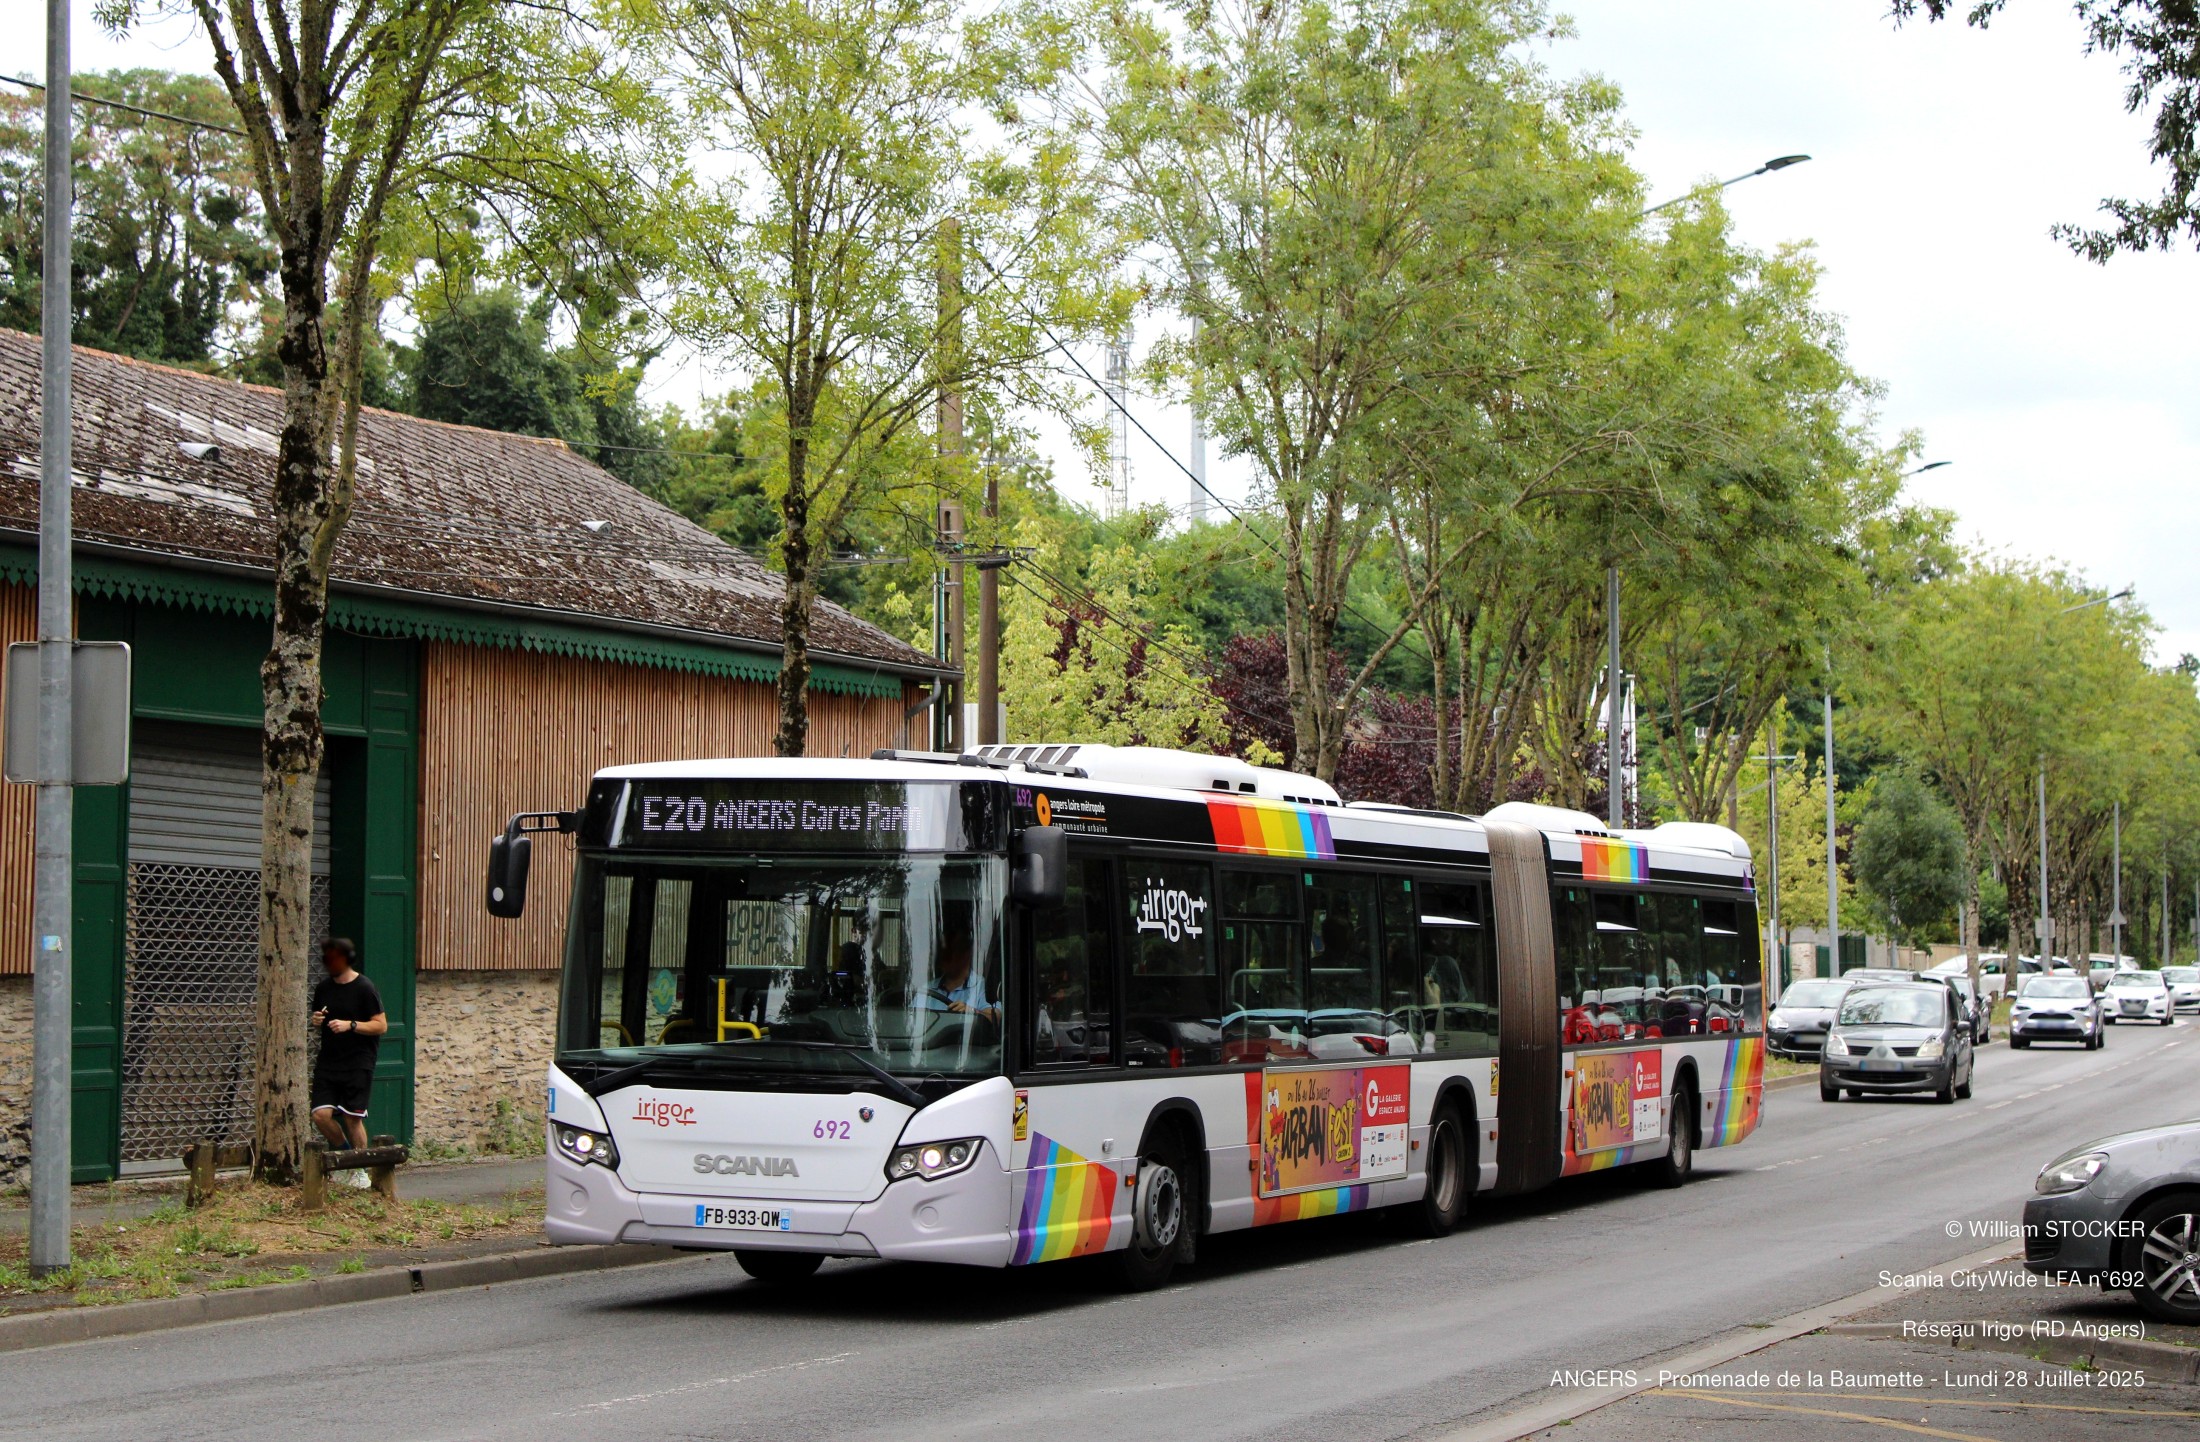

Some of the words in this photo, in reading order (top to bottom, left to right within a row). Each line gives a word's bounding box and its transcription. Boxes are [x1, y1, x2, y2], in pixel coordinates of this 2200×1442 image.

[1016, 788, 1033, 808] 692
[1050, 800, 1068, 812] angers
[1068, 799, 1080, 811] loire
[643, 796, 706, 831] E20
[714, 800, 796, 830] ANGERS
[802, 800, 862, 831] Gares
[1087, 824, 1108, 833] urbaine
[1636, 1061, 1643, 1092] G
[1366, 1079, 1379, 1118] G
[637, 1097, 691, 1127] irigo
[813, 1120, 851, 1140] 692
[1281, 1104, 1326, 1169] URBAN
[693, 1153, 799, 1178] SCANIA
[705, 1208, 780, 1227] FB-933-QW
